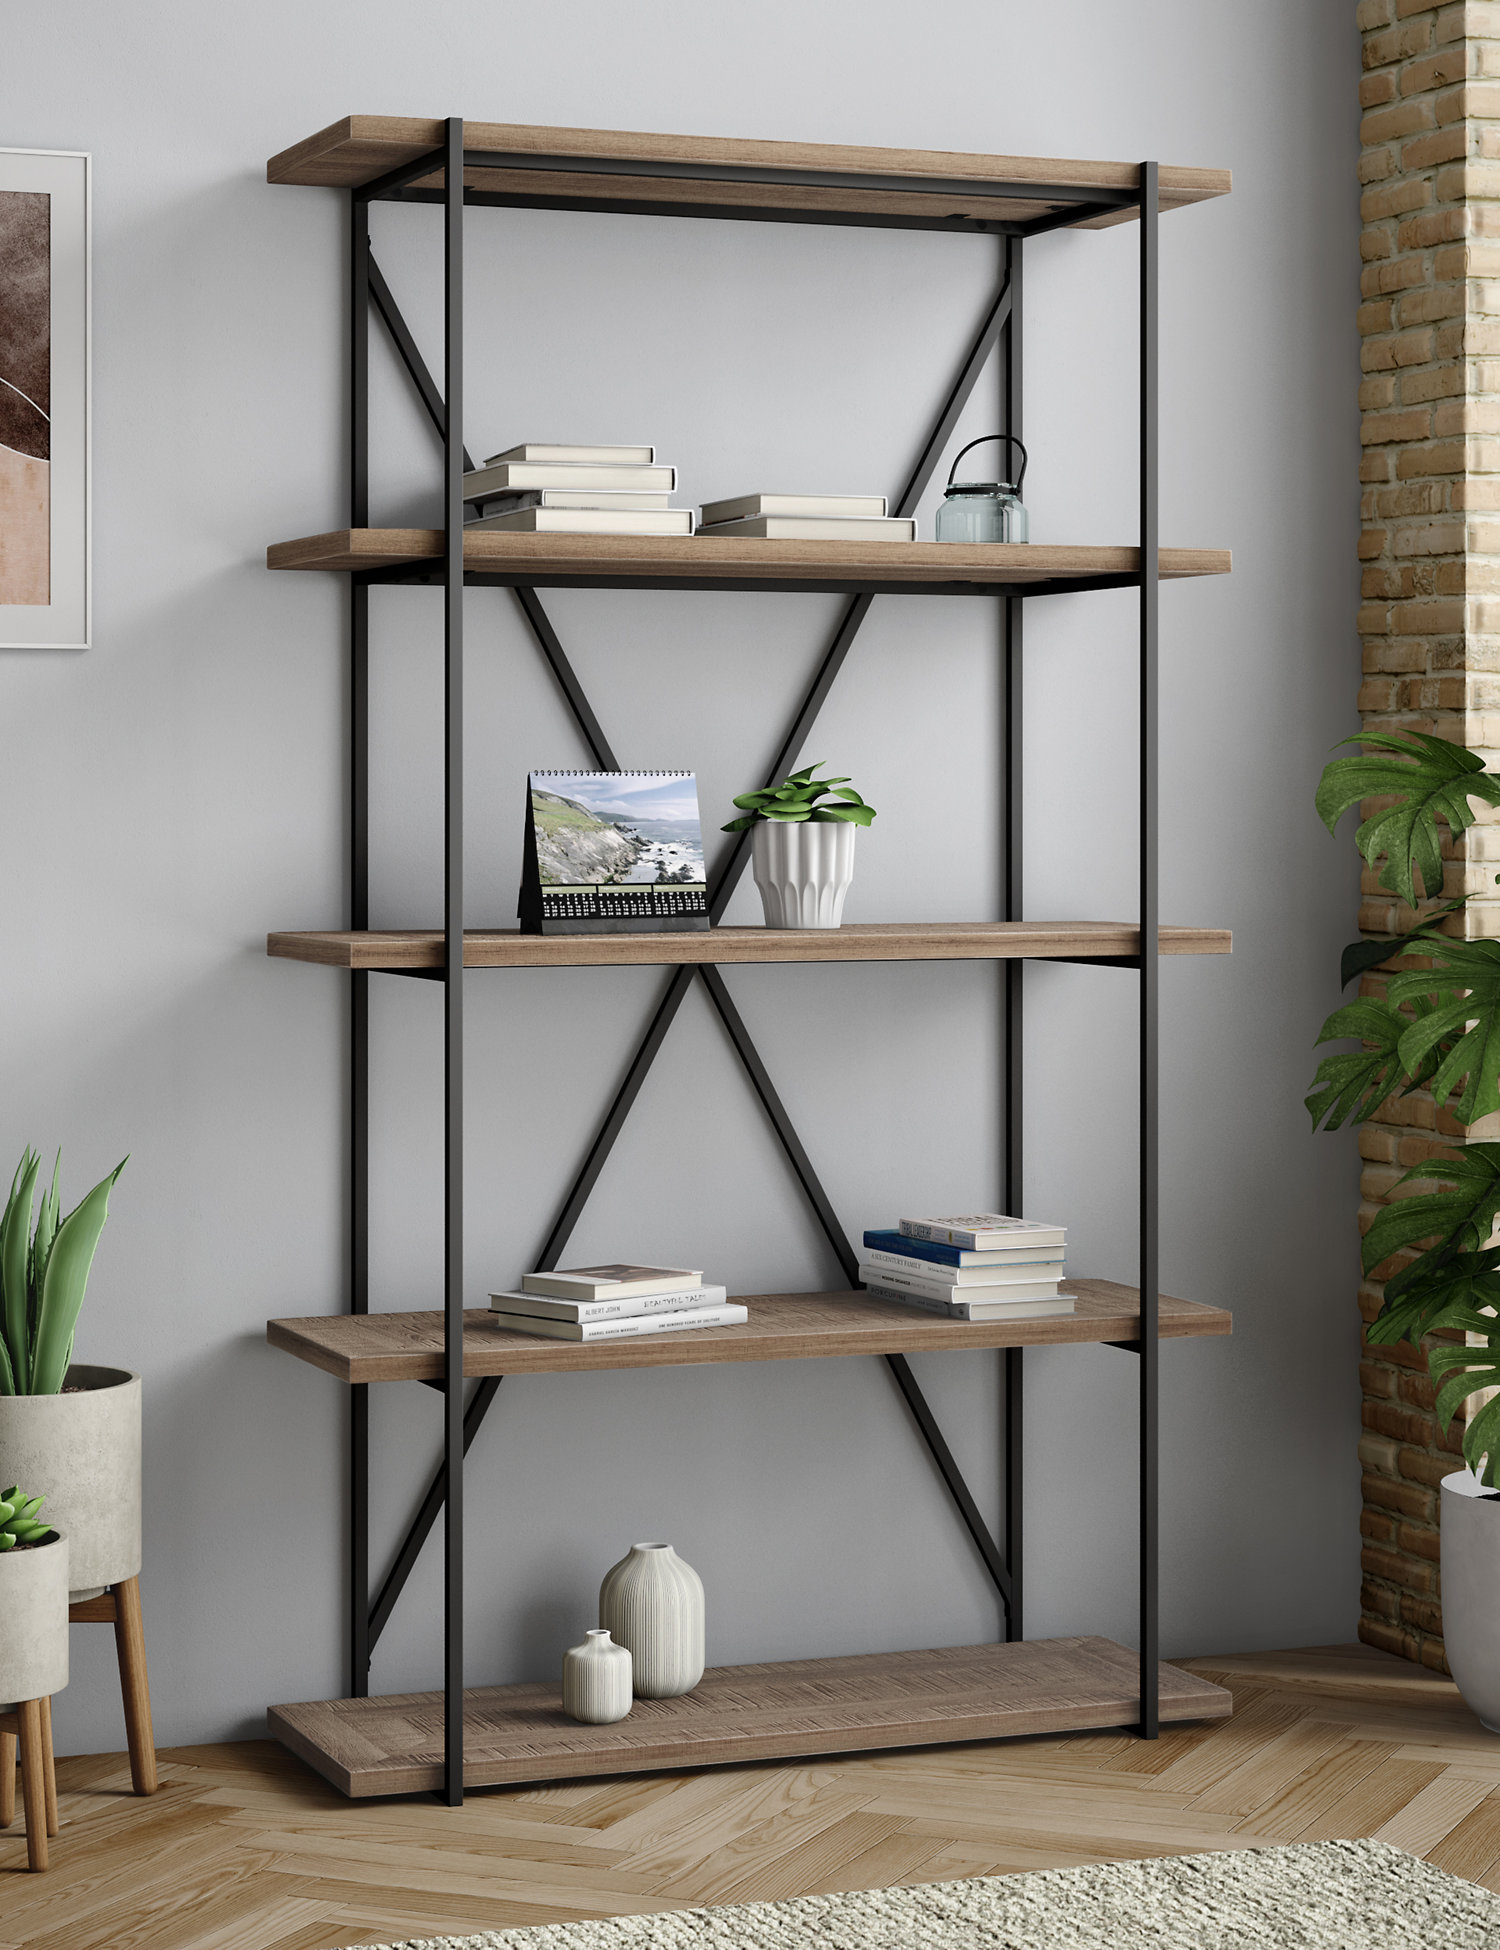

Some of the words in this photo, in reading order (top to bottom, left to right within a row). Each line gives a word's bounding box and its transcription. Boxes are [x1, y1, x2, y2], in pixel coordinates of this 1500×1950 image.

[882, 1254, 904, 1266] CENTURY
[904, 1260, 922, 1270] FAMILY
[585, 1307, 604, 1316] ALBERT
